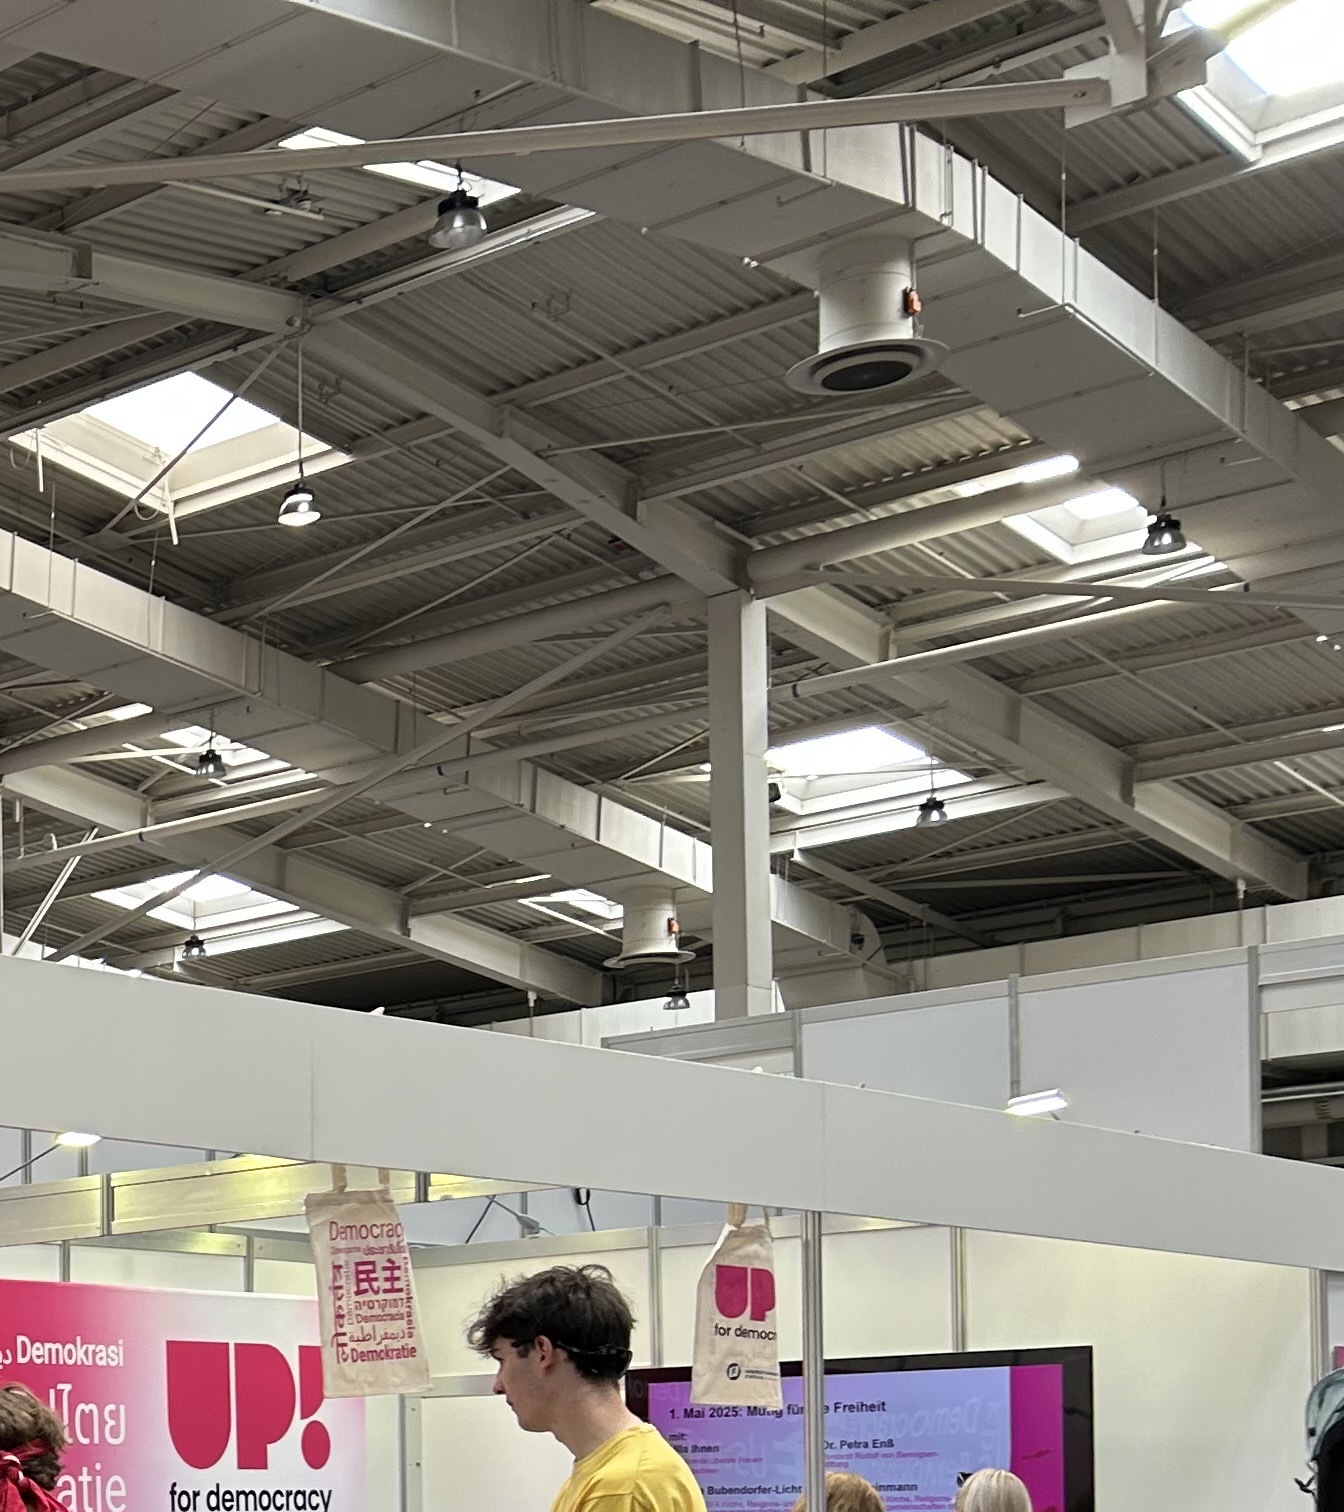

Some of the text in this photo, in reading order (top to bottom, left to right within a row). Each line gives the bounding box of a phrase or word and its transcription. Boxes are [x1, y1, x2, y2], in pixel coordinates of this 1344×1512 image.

[354, 1257, 405, 1296] 民主
[714, 1323, 731, 1338] for
[16, 1335, 124, 1367] Demokrasi
[166, 1340, 331, 1470] UP!
[833, 1401, 886, 1414] Freiheit
[683, 1407, 705, 1419] Mai
[839, 1439, 869, 1450] Petra
[169, 1481, 201, 1512] for
[706, 1484, 803, 1496] Bubendorfer-Licht
